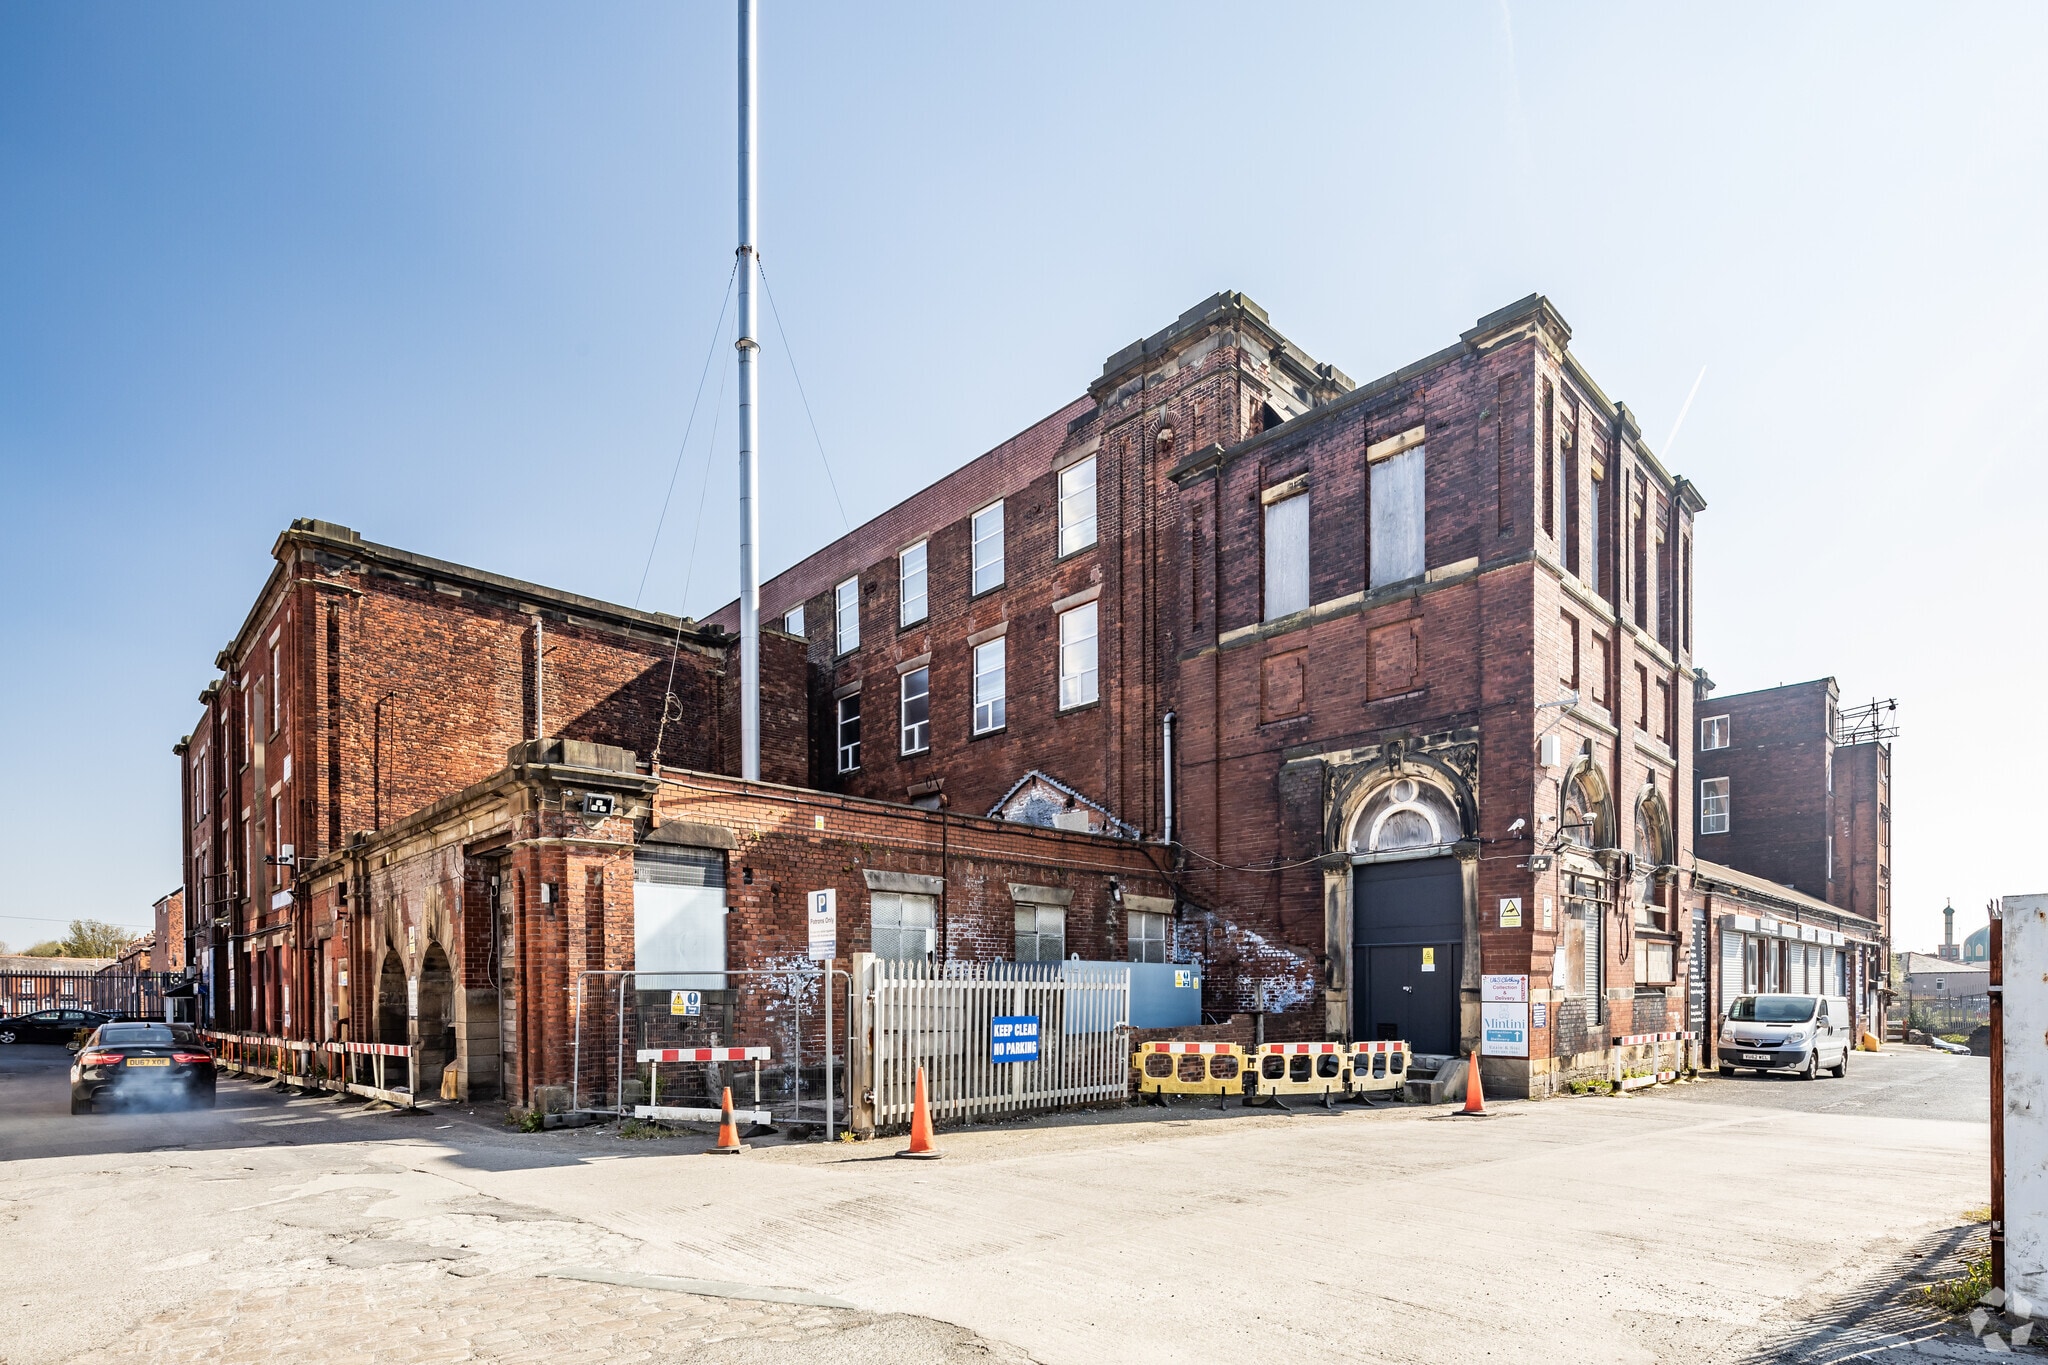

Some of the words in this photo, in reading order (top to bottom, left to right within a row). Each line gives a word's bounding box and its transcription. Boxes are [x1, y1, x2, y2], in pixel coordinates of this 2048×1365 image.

[825, 916, 834, 924] Only
[1484, 1018, 1525, 1029] Mintini
[994, 1024, 1013, 1037] KEEP
[1014, 1023, 1037, 1036] CLEAR
[994, 1042, 1005, 1056] NO
[1006, 1041, 1037, 1055] PARKING
